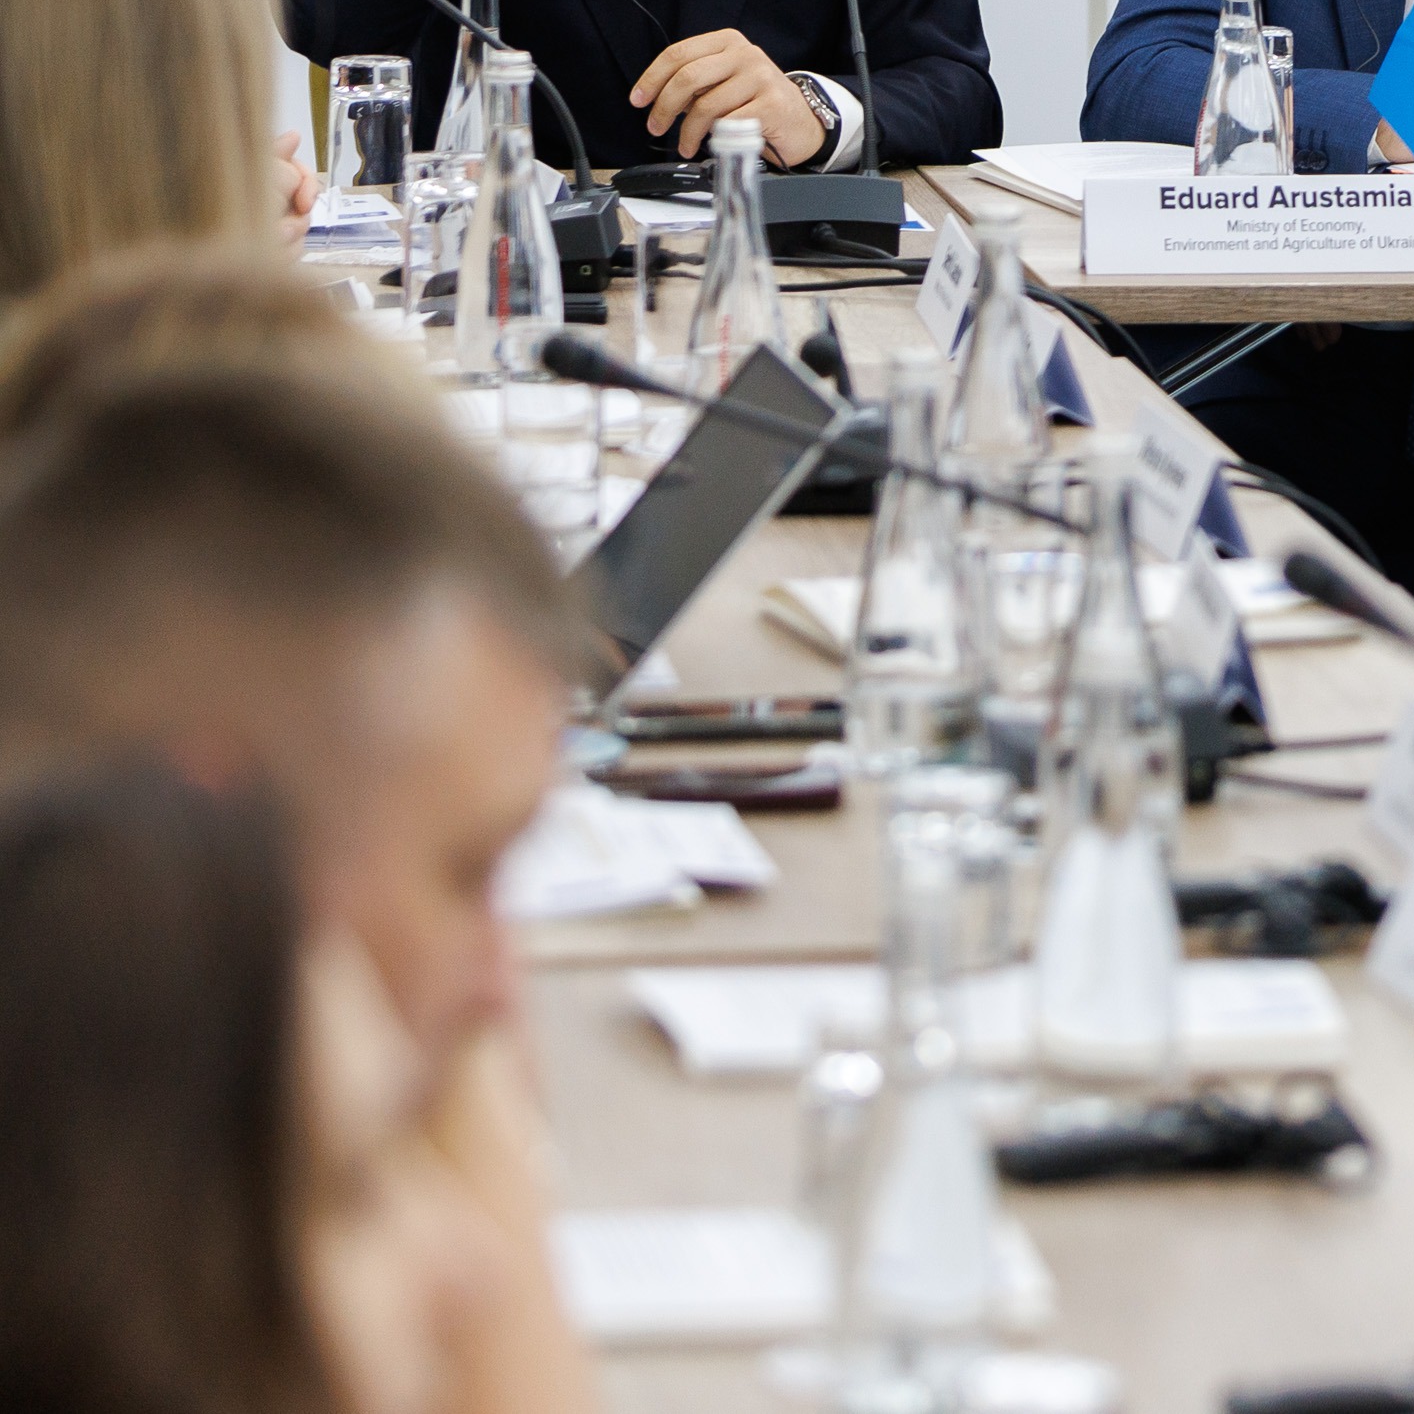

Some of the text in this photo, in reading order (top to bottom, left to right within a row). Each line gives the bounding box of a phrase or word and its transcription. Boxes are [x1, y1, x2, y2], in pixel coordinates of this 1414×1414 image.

[1160, 186, 1260, 211] Eduard
[1227, 218, 1367, 237] Ministry of Economy,
[1163, 237, 1251, 253] Environment
[1253, 237, 1280, 253] and
[1281, 236, 1358, 255] Agriculture
[1360, 235, 1375, 251] of
